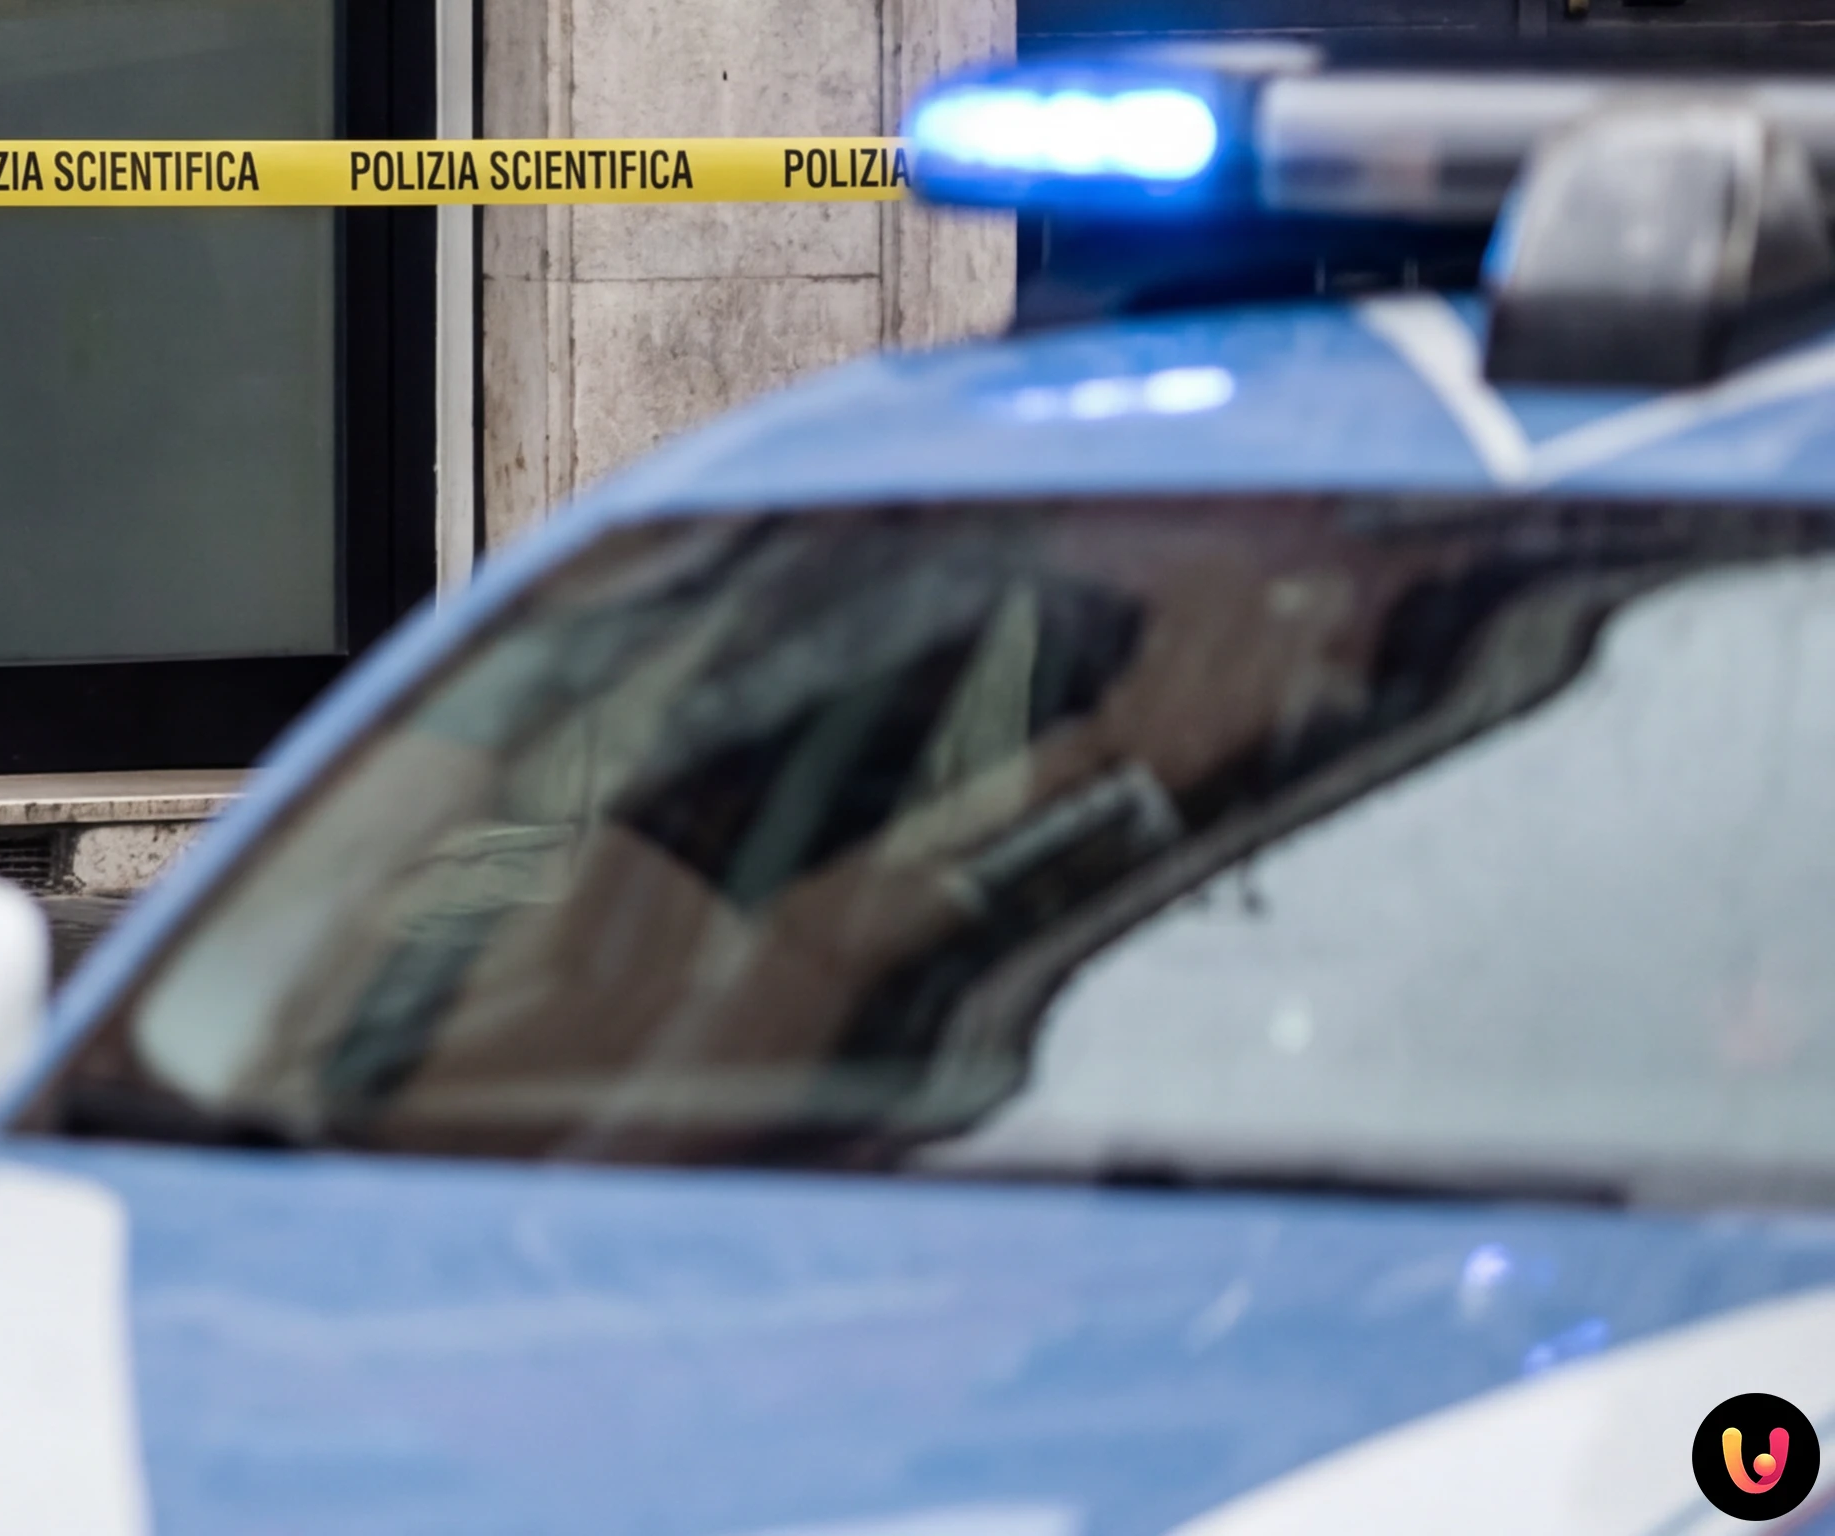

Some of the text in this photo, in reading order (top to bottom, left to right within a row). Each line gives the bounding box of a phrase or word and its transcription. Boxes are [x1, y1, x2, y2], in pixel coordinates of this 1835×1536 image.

[54, 151, 260, 192] SCIENTIFICA
[351, 150, 693, 192] POLIZIA SCIENTIFICA
[784, 148, 911, 189] POLIZIA
